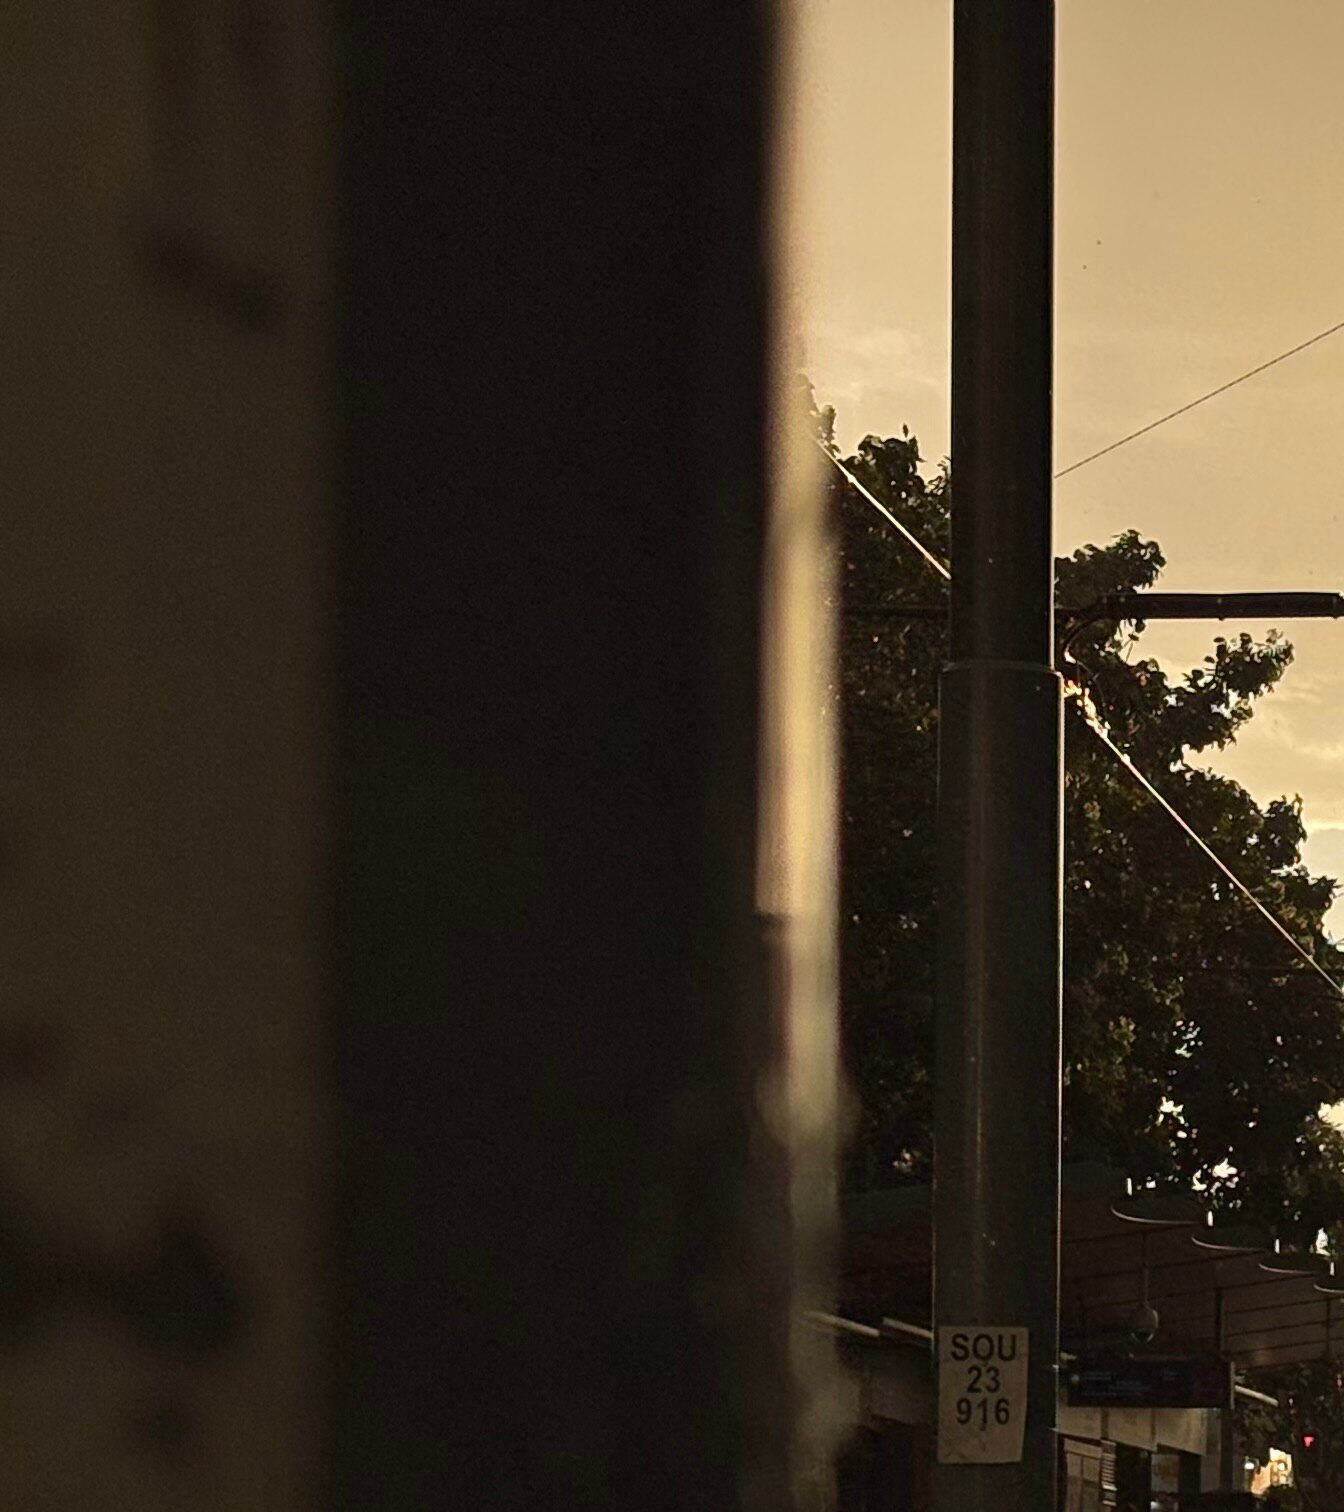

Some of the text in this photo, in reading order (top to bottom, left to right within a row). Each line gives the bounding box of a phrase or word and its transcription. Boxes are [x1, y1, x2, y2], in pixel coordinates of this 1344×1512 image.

[951, 1333, 1017, 1361] SOU
[967, 1366, 1000, 1393] 23
[956, 1398, 1010, 1425] 916
